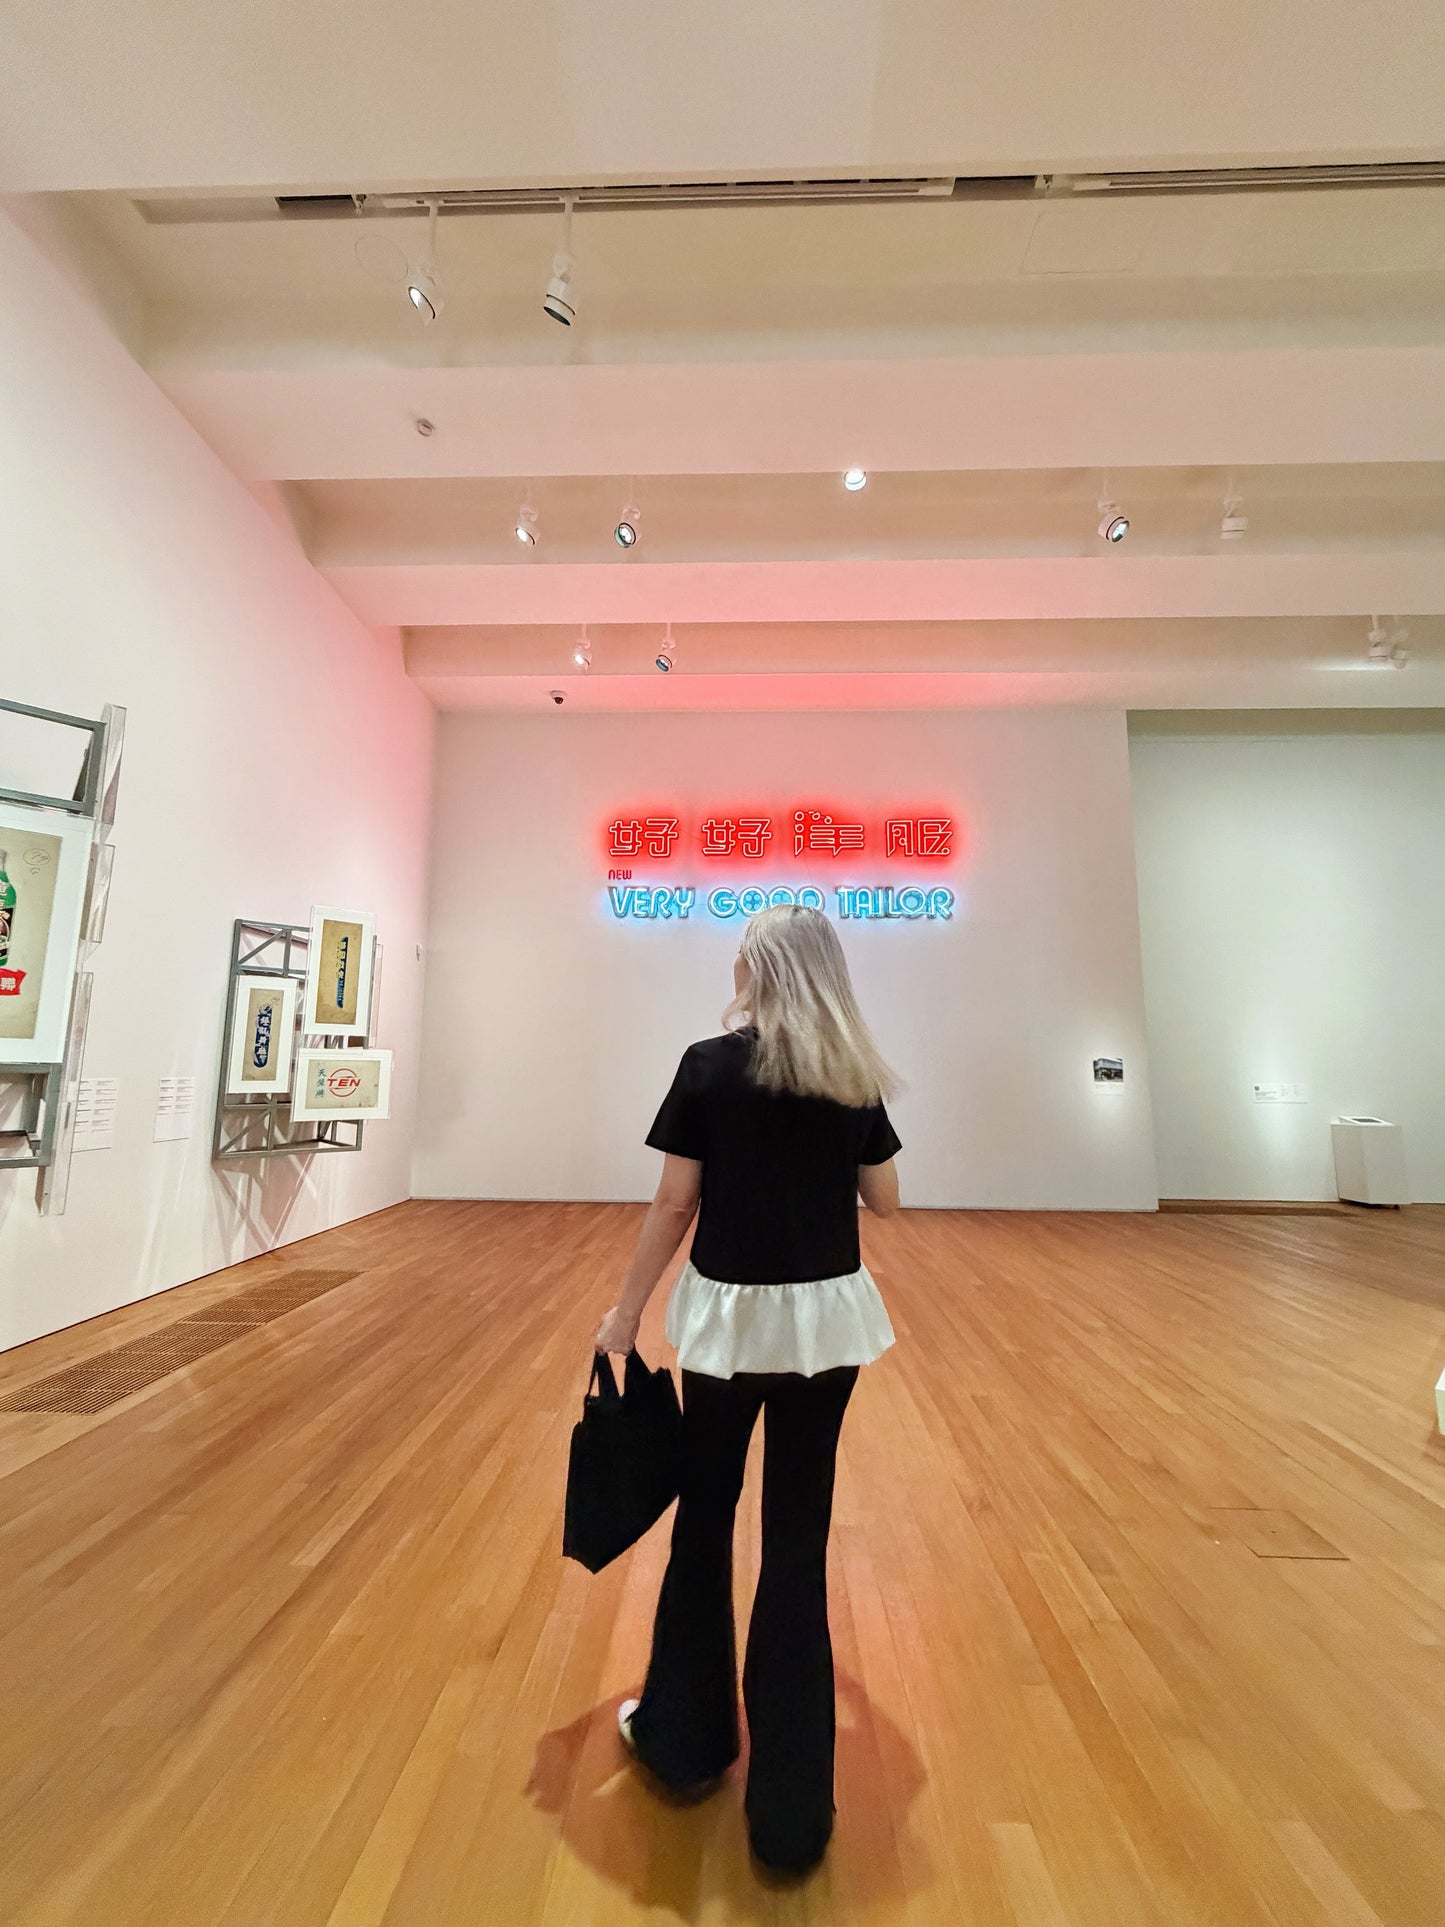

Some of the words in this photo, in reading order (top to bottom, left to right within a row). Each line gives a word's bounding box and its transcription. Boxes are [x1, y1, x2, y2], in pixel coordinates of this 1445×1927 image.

[608, 869, 632, 880] NEW
[608, 886, 696, 918] VERY
[835, 886, 955, 918] TAILOR
[327, 1078, 361, 1087] TEN
